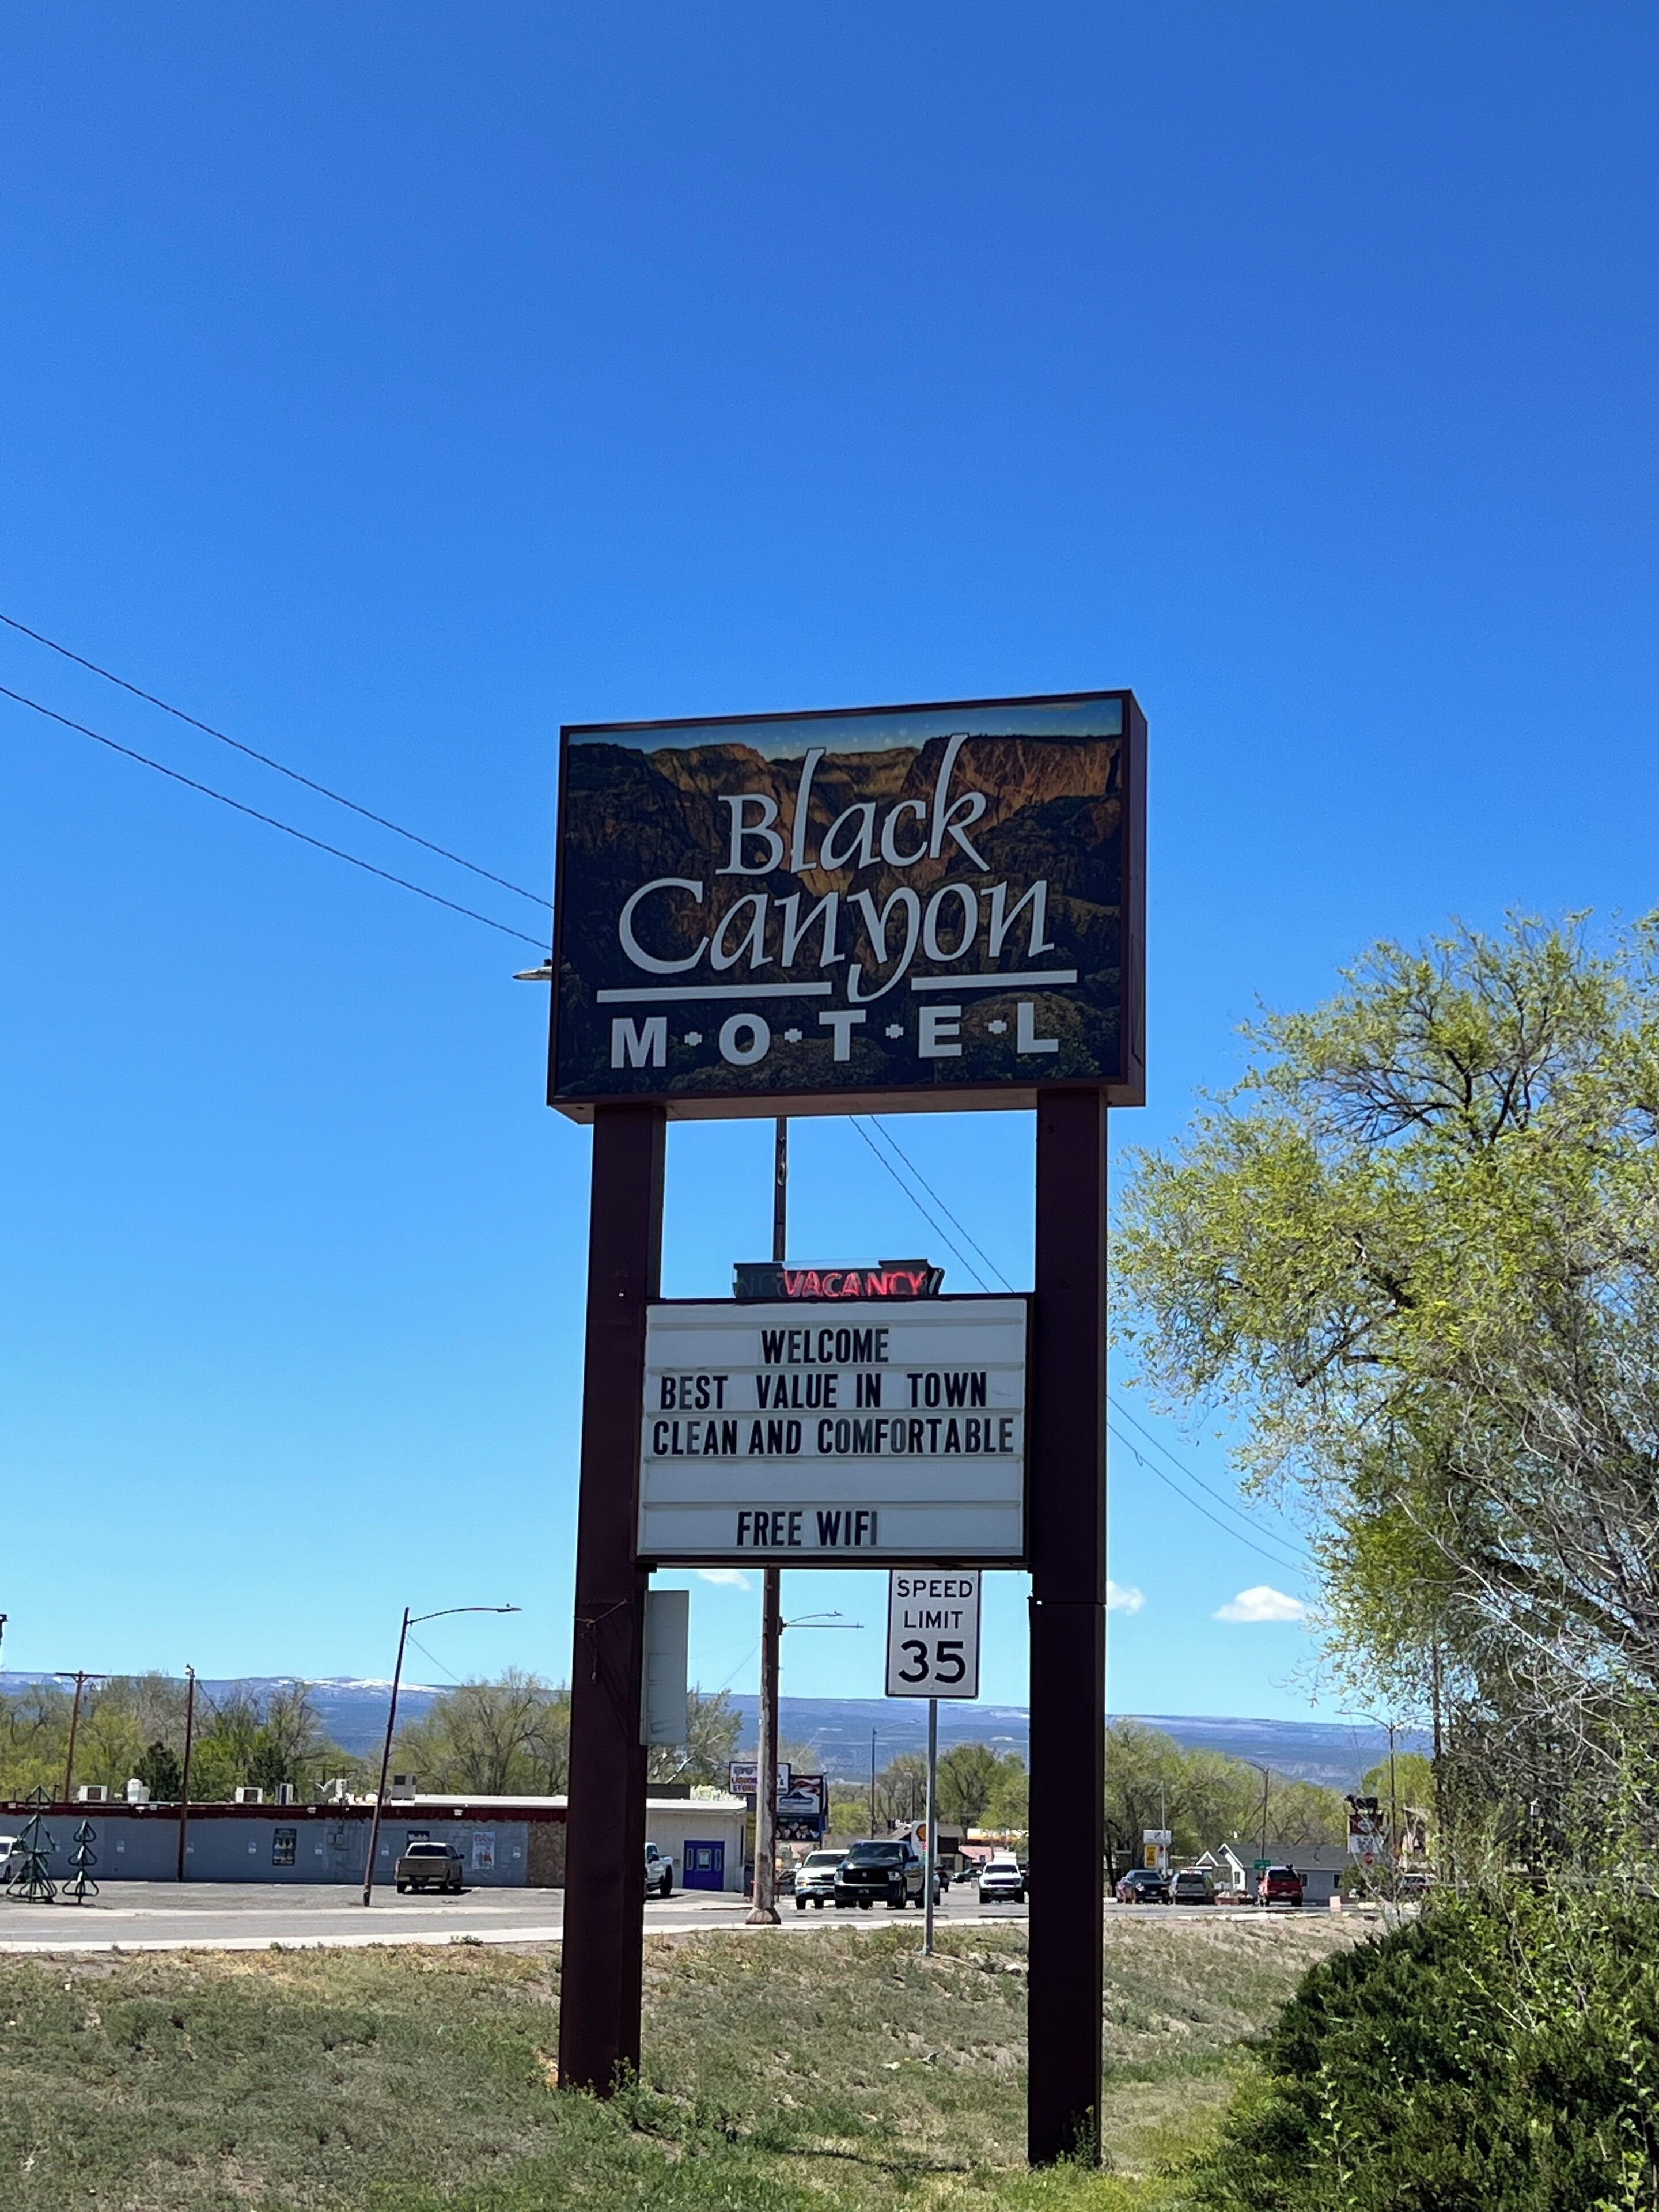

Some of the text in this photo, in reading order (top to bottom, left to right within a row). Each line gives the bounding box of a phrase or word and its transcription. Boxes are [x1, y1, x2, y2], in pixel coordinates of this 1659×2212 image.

[715, 734, 990, 875] Black
[619, 878, 1055, 1002] Canyon
[781, 1270, 927, 1297] VACANCY
[761, 1328, 889, 1364] WELCOME
[660, 1371, 987, 1410] BEST VALUE IN TOWN
[653, 1418, 1014, 1455] CLEAN AND COMFORTABLE
[737, 1510, 877, 1547] FREE WIFI
[897, 1579, 973, 1598] SPEED
[904, 1610, 964, 1629] LIMIT
[898, 1639, 966, 1683] 35
